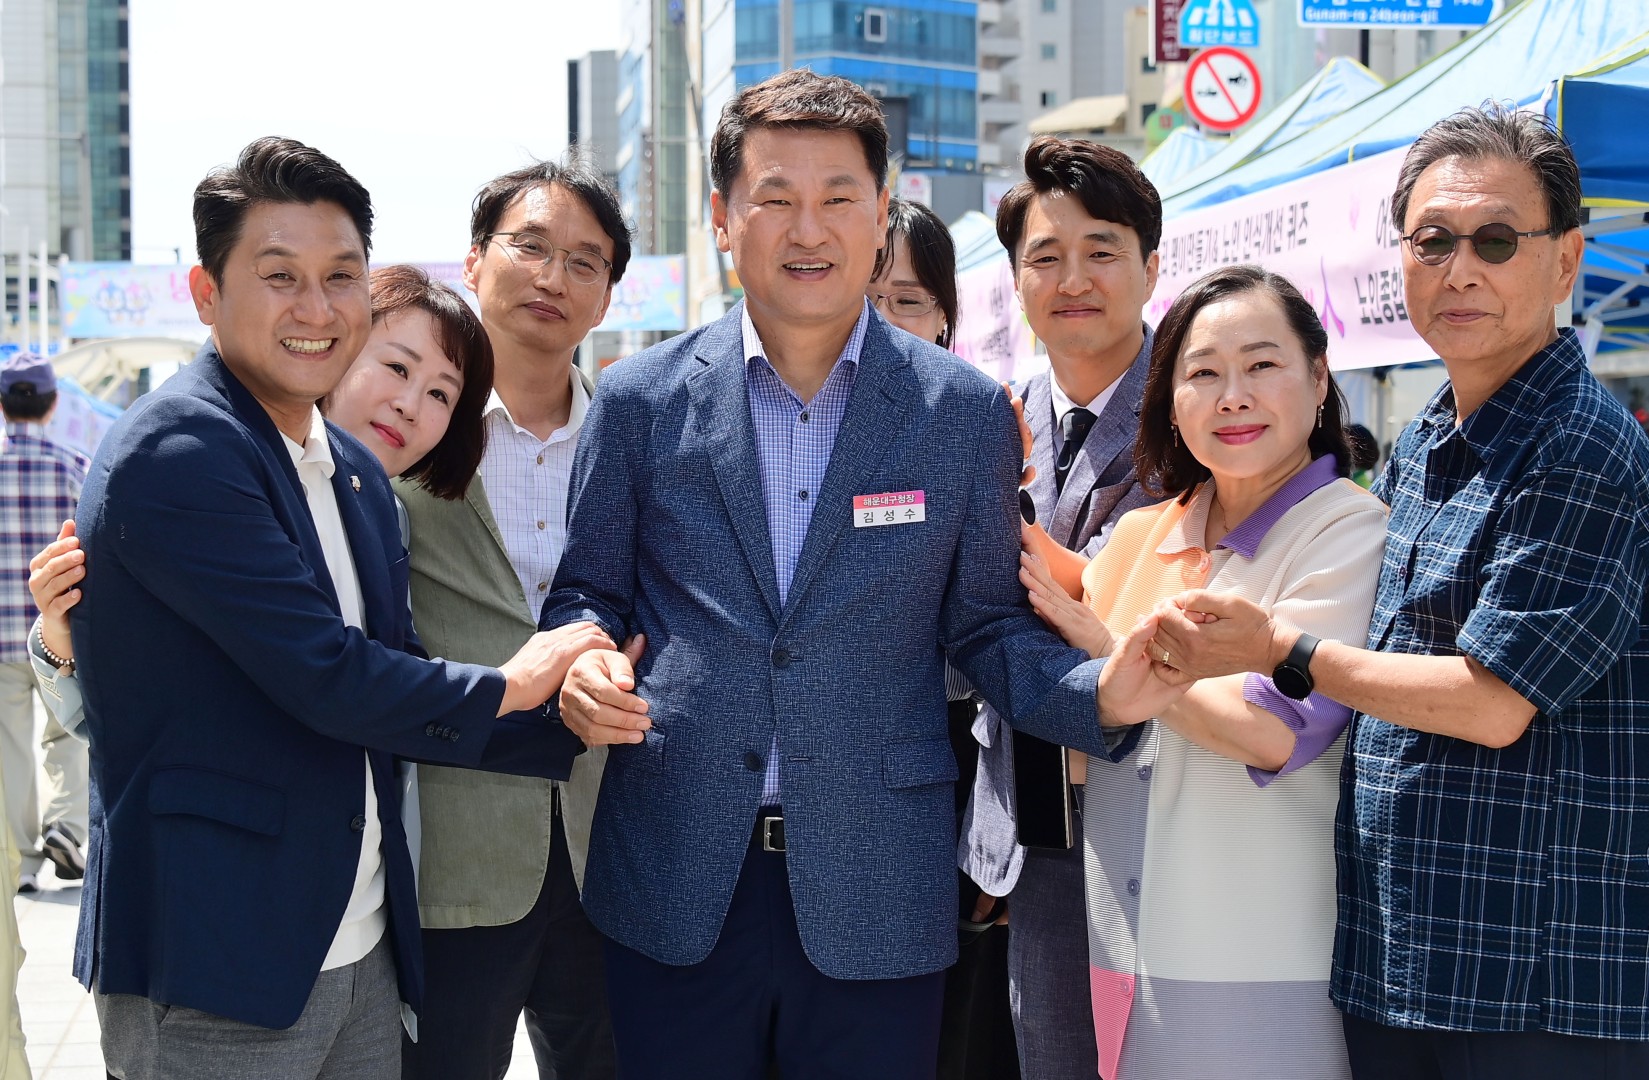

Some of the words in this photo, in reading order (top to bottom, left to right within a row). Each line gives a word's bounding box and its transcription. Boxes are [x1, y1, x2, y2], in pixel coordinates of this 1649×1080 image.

[1305, 6, 1368, 22] Gunam-ro
[1369, 7, 1439, 25] 24beon-gil
[1222, 219, 1241, 263] 노인
[1243, 206, 1285, 260] 인식개선
[1287, 200, 1309, 250] 퀴즈
[863, 493, 915, 507] 해운대구청장
